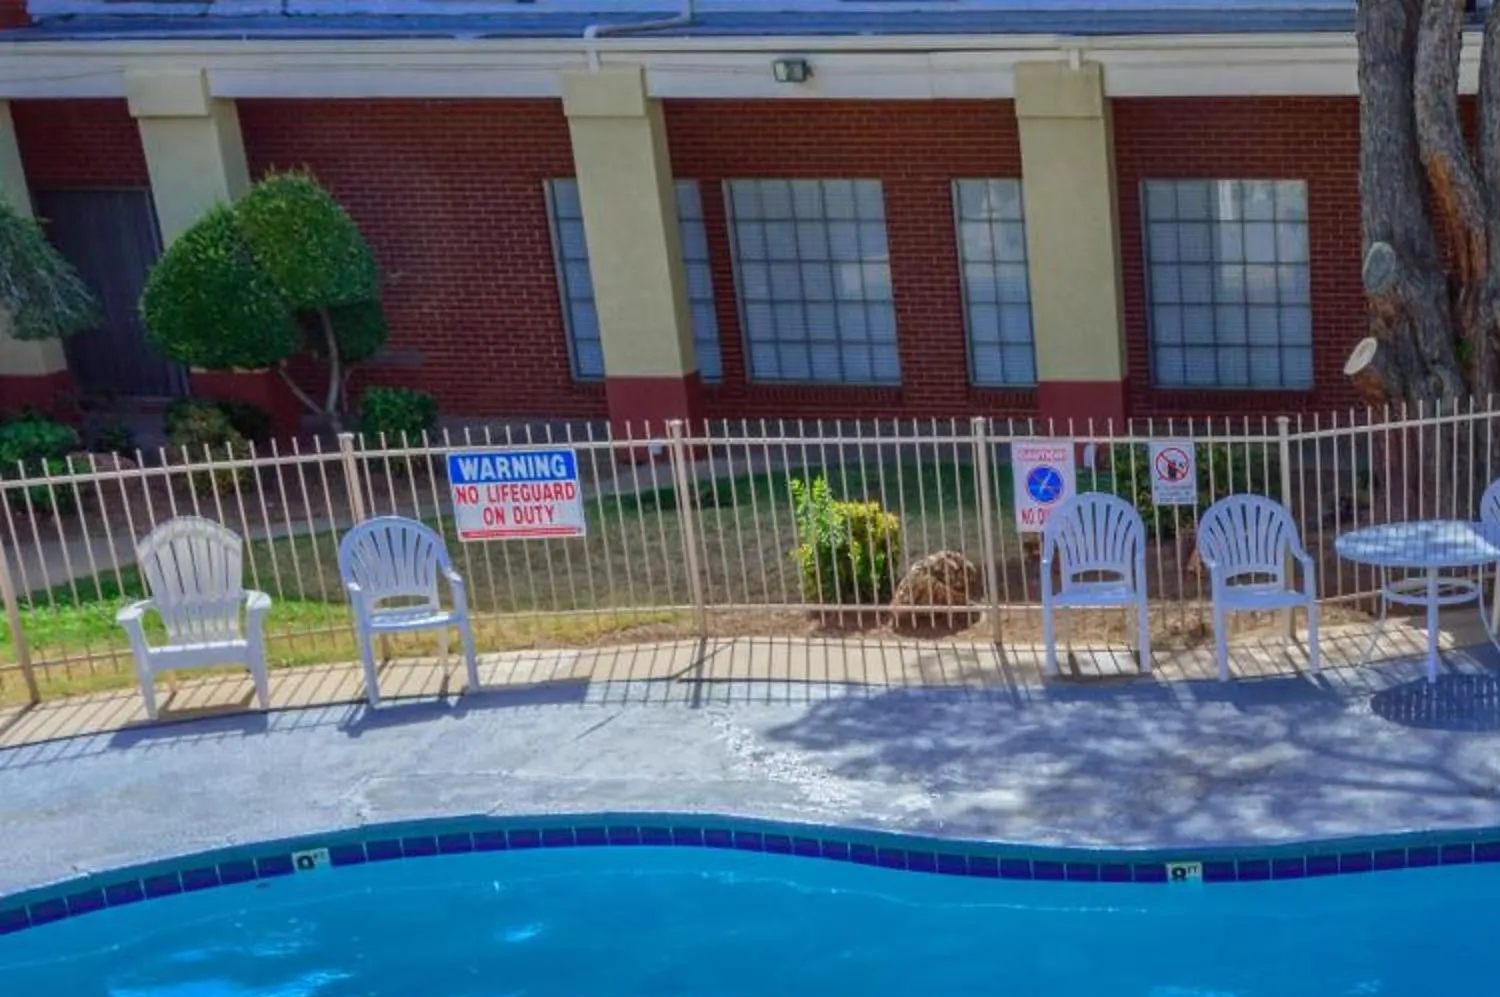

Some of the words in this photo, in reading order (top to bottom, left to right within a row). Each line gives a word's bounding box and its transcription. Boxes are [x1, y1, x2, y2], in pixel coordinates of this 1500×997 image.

[457, 453, 568, 481] WARNING
[456, 485, 479, 504] NO
[487, 481, 576, 503] LIFEGUARD
[483, 507, 505, 525] ON
[512, 505, 555, 525] DUTY
[1021, 507, 1035, 524] NO
